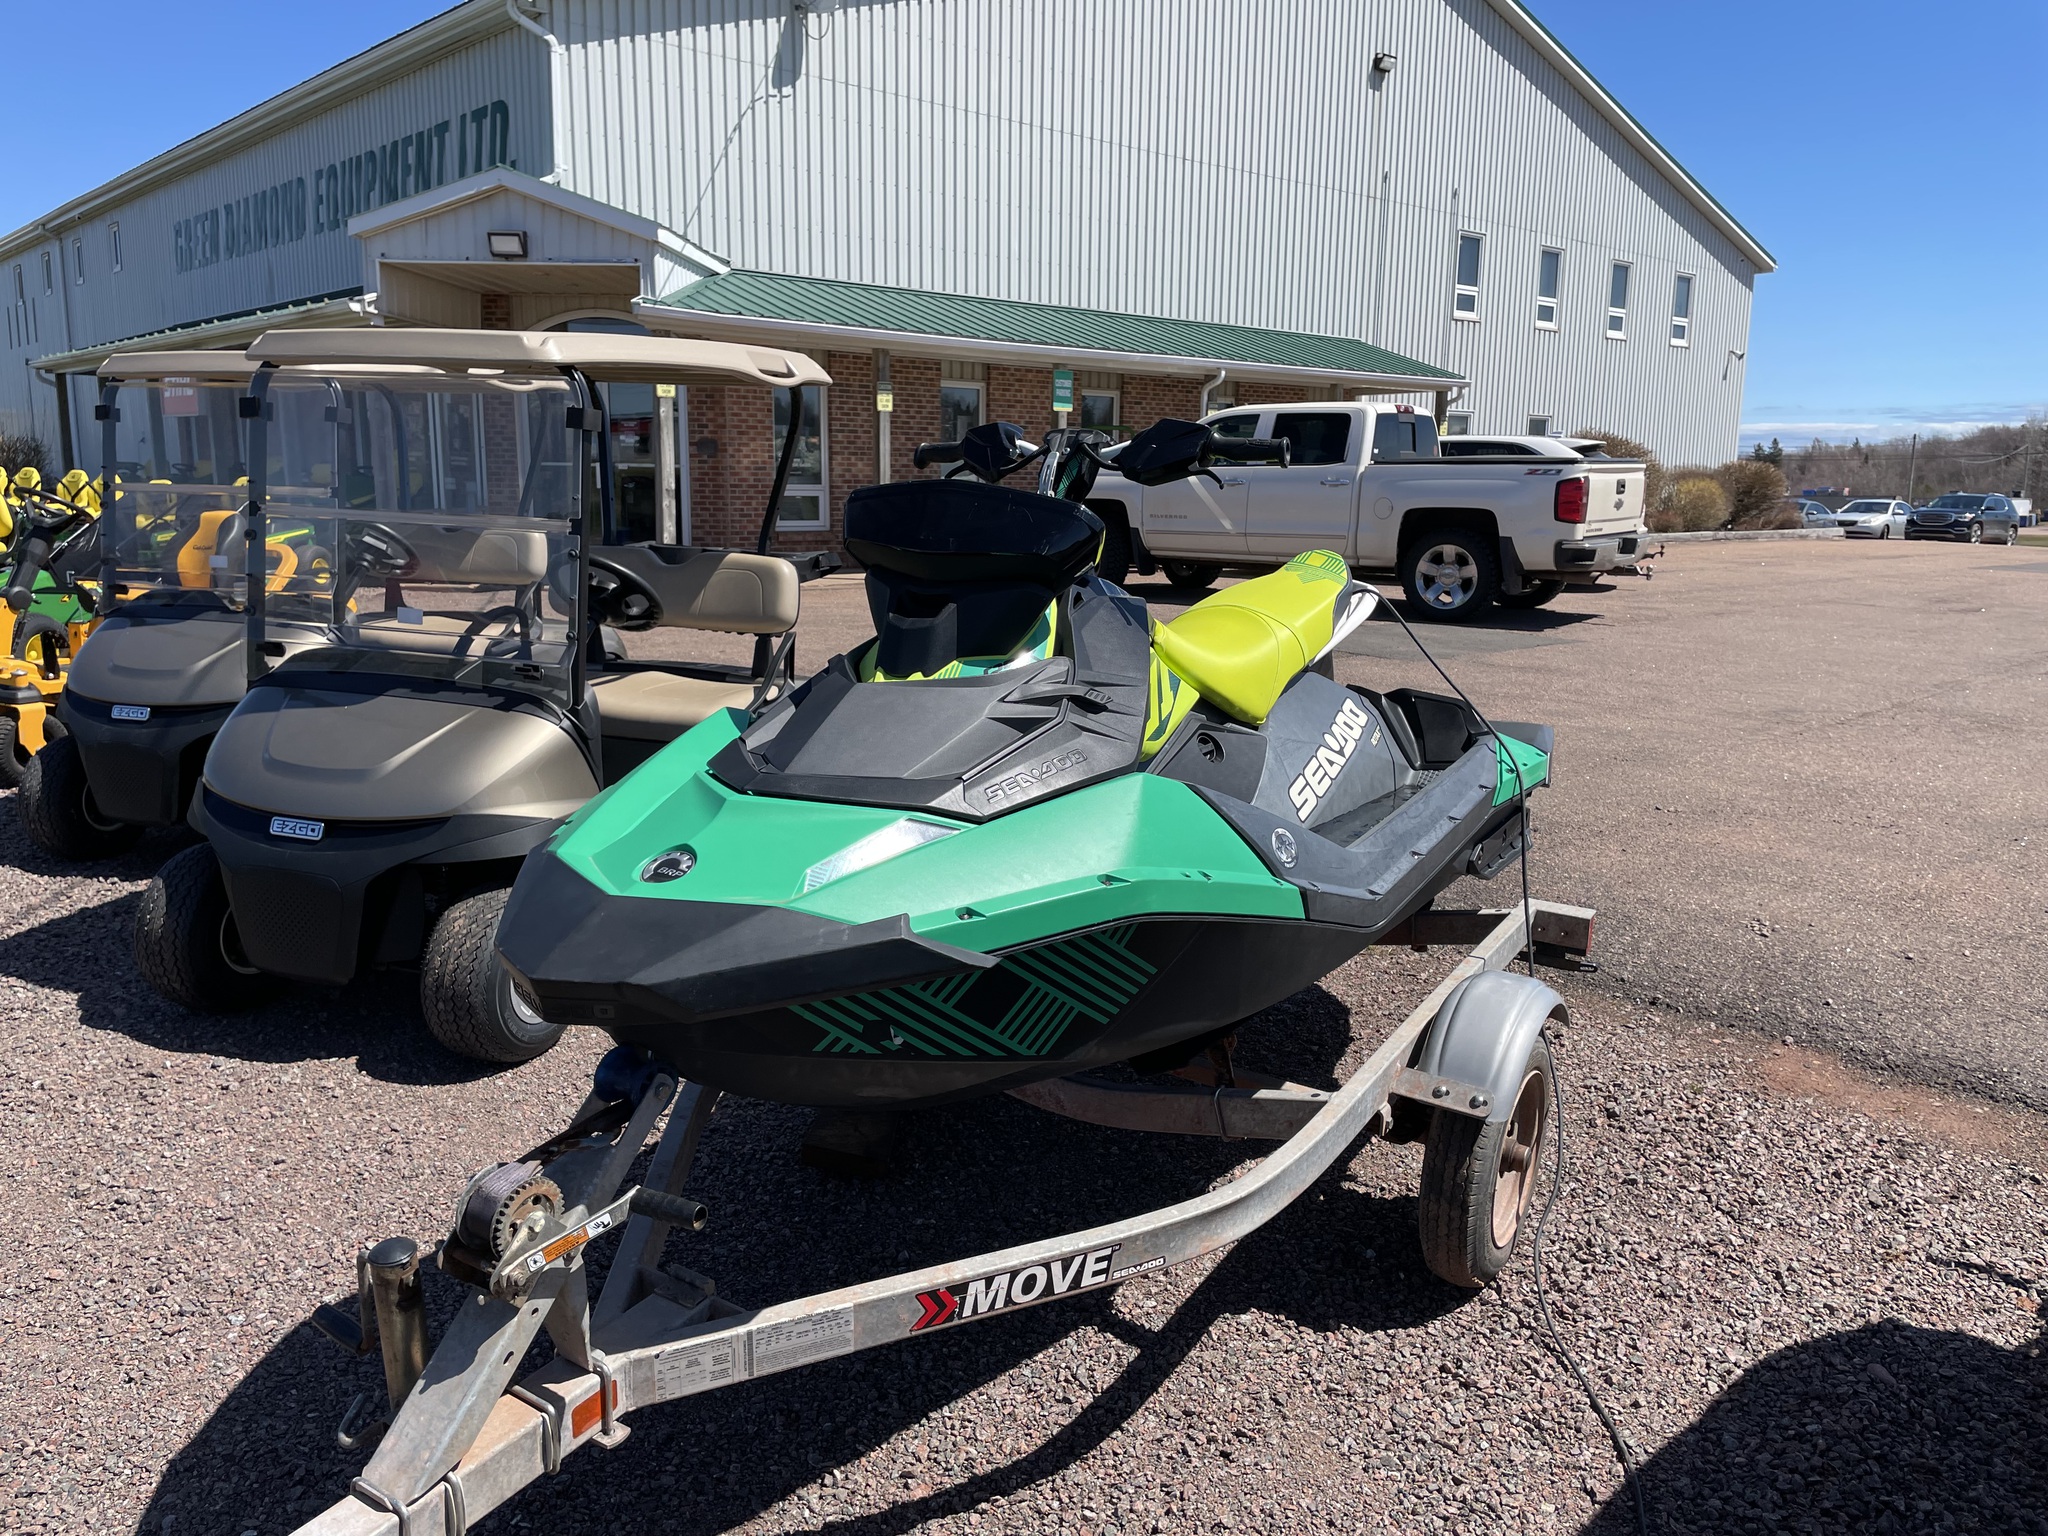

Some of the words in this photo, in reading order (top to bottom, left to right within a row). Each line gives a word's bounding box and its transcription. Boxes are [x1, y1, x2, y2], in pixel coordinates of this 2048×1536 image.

[173, 208, 220, 275] GREEN
[223, 176, 306, 261] DIAMOND
[314, 120, 449, 236] EQUIPMENT
[657, 866, 684, 877] BRP
[962, 1246, 1112, 1318] MOVE
